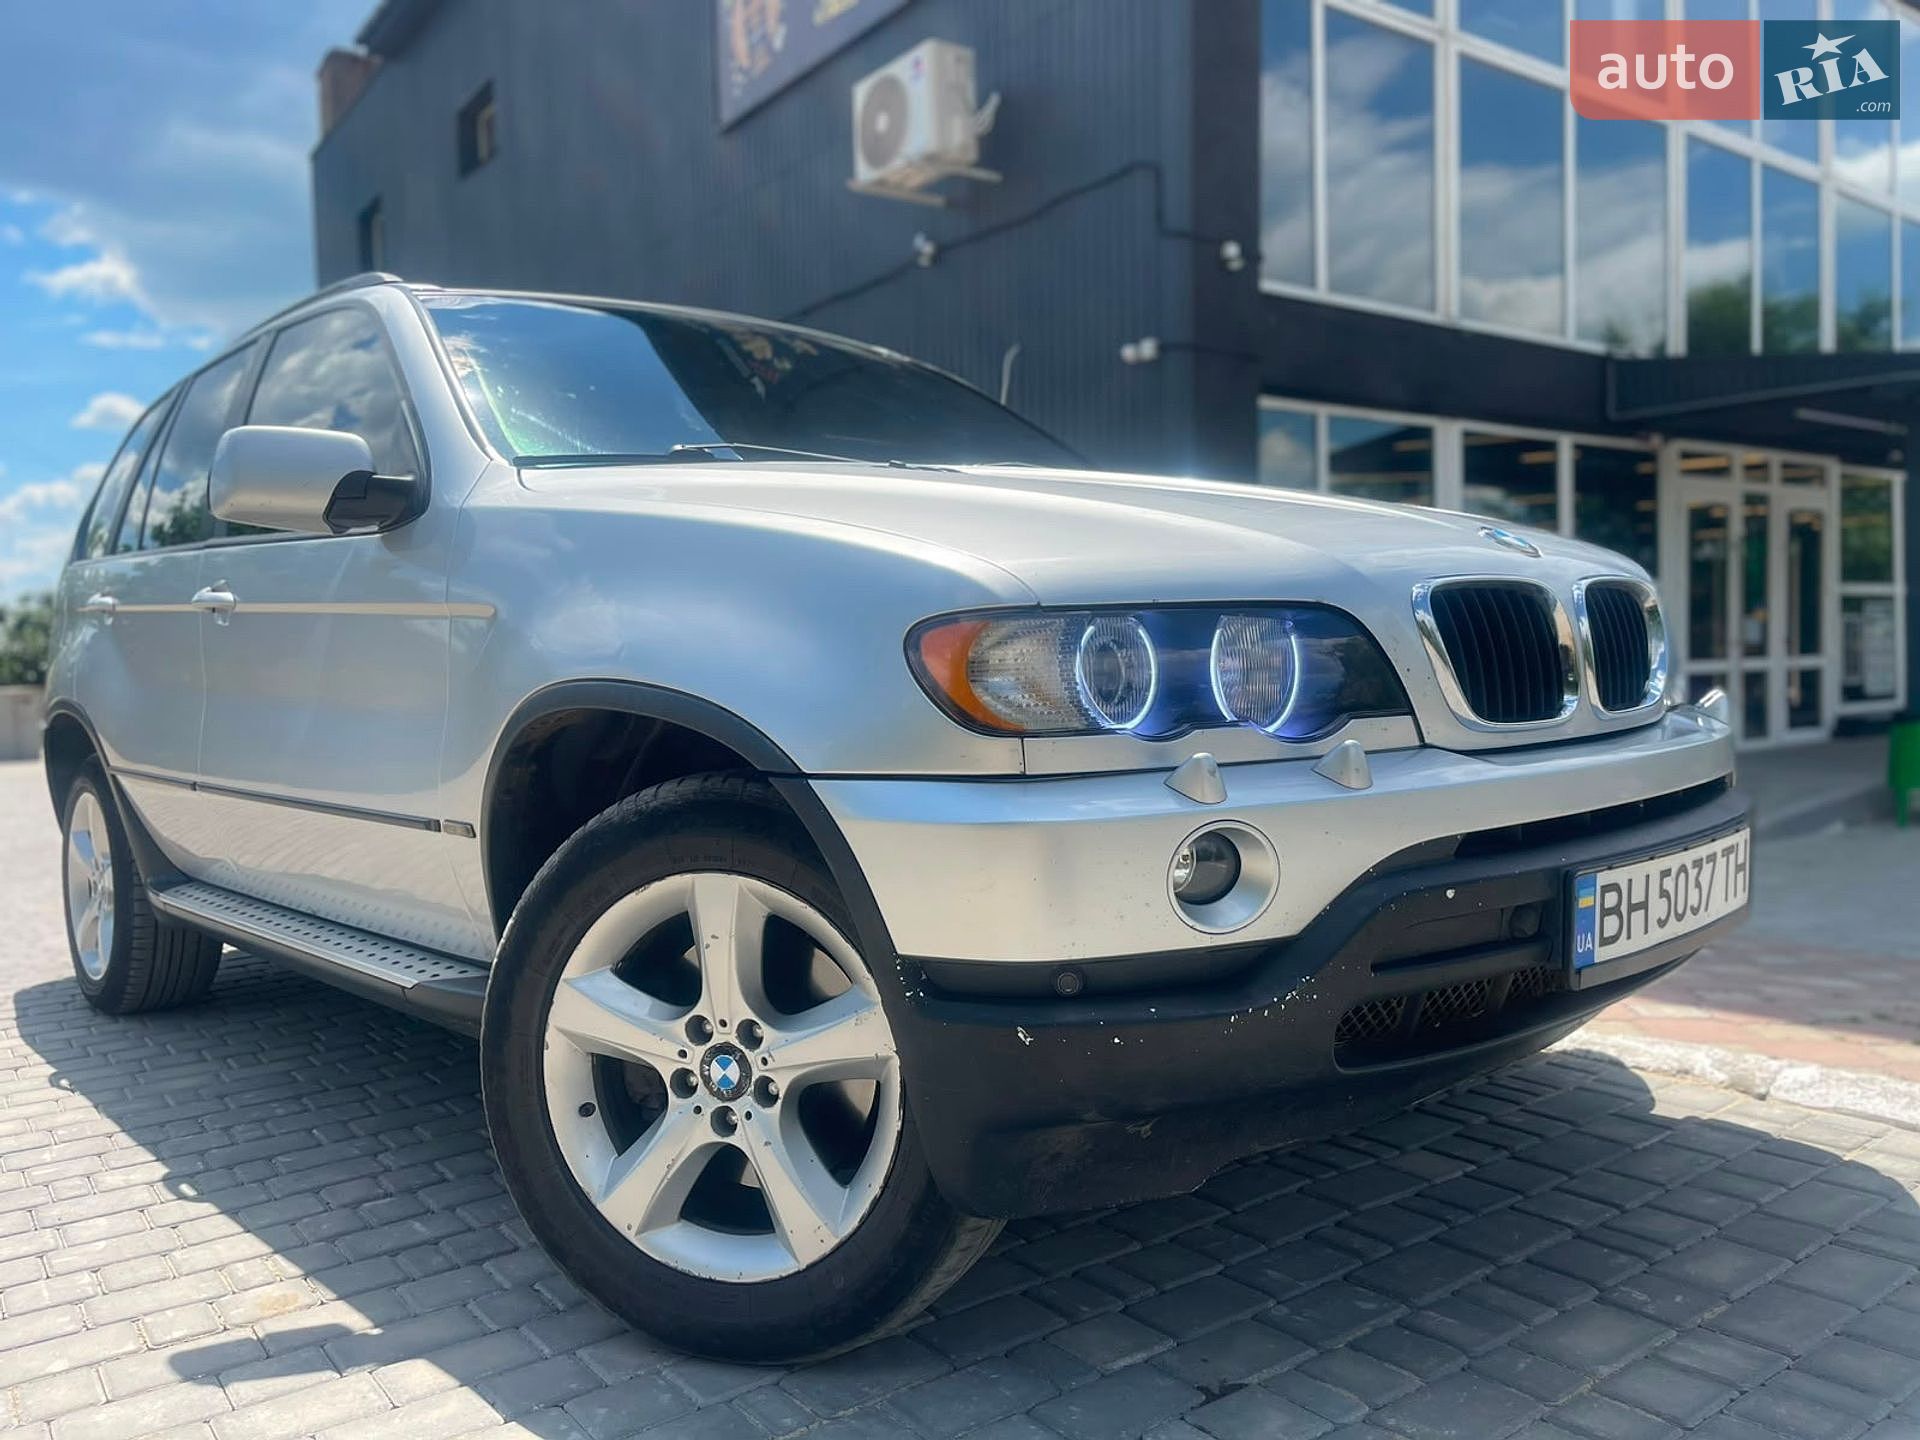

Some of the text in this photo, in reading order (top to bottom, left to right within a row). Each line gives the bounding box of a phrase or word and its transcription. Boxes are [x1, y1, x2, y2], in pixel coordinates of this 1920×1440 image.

[1598, 839, 1748, 948] BH 5037 TH
[1576, 932, 1593, 953] UA
